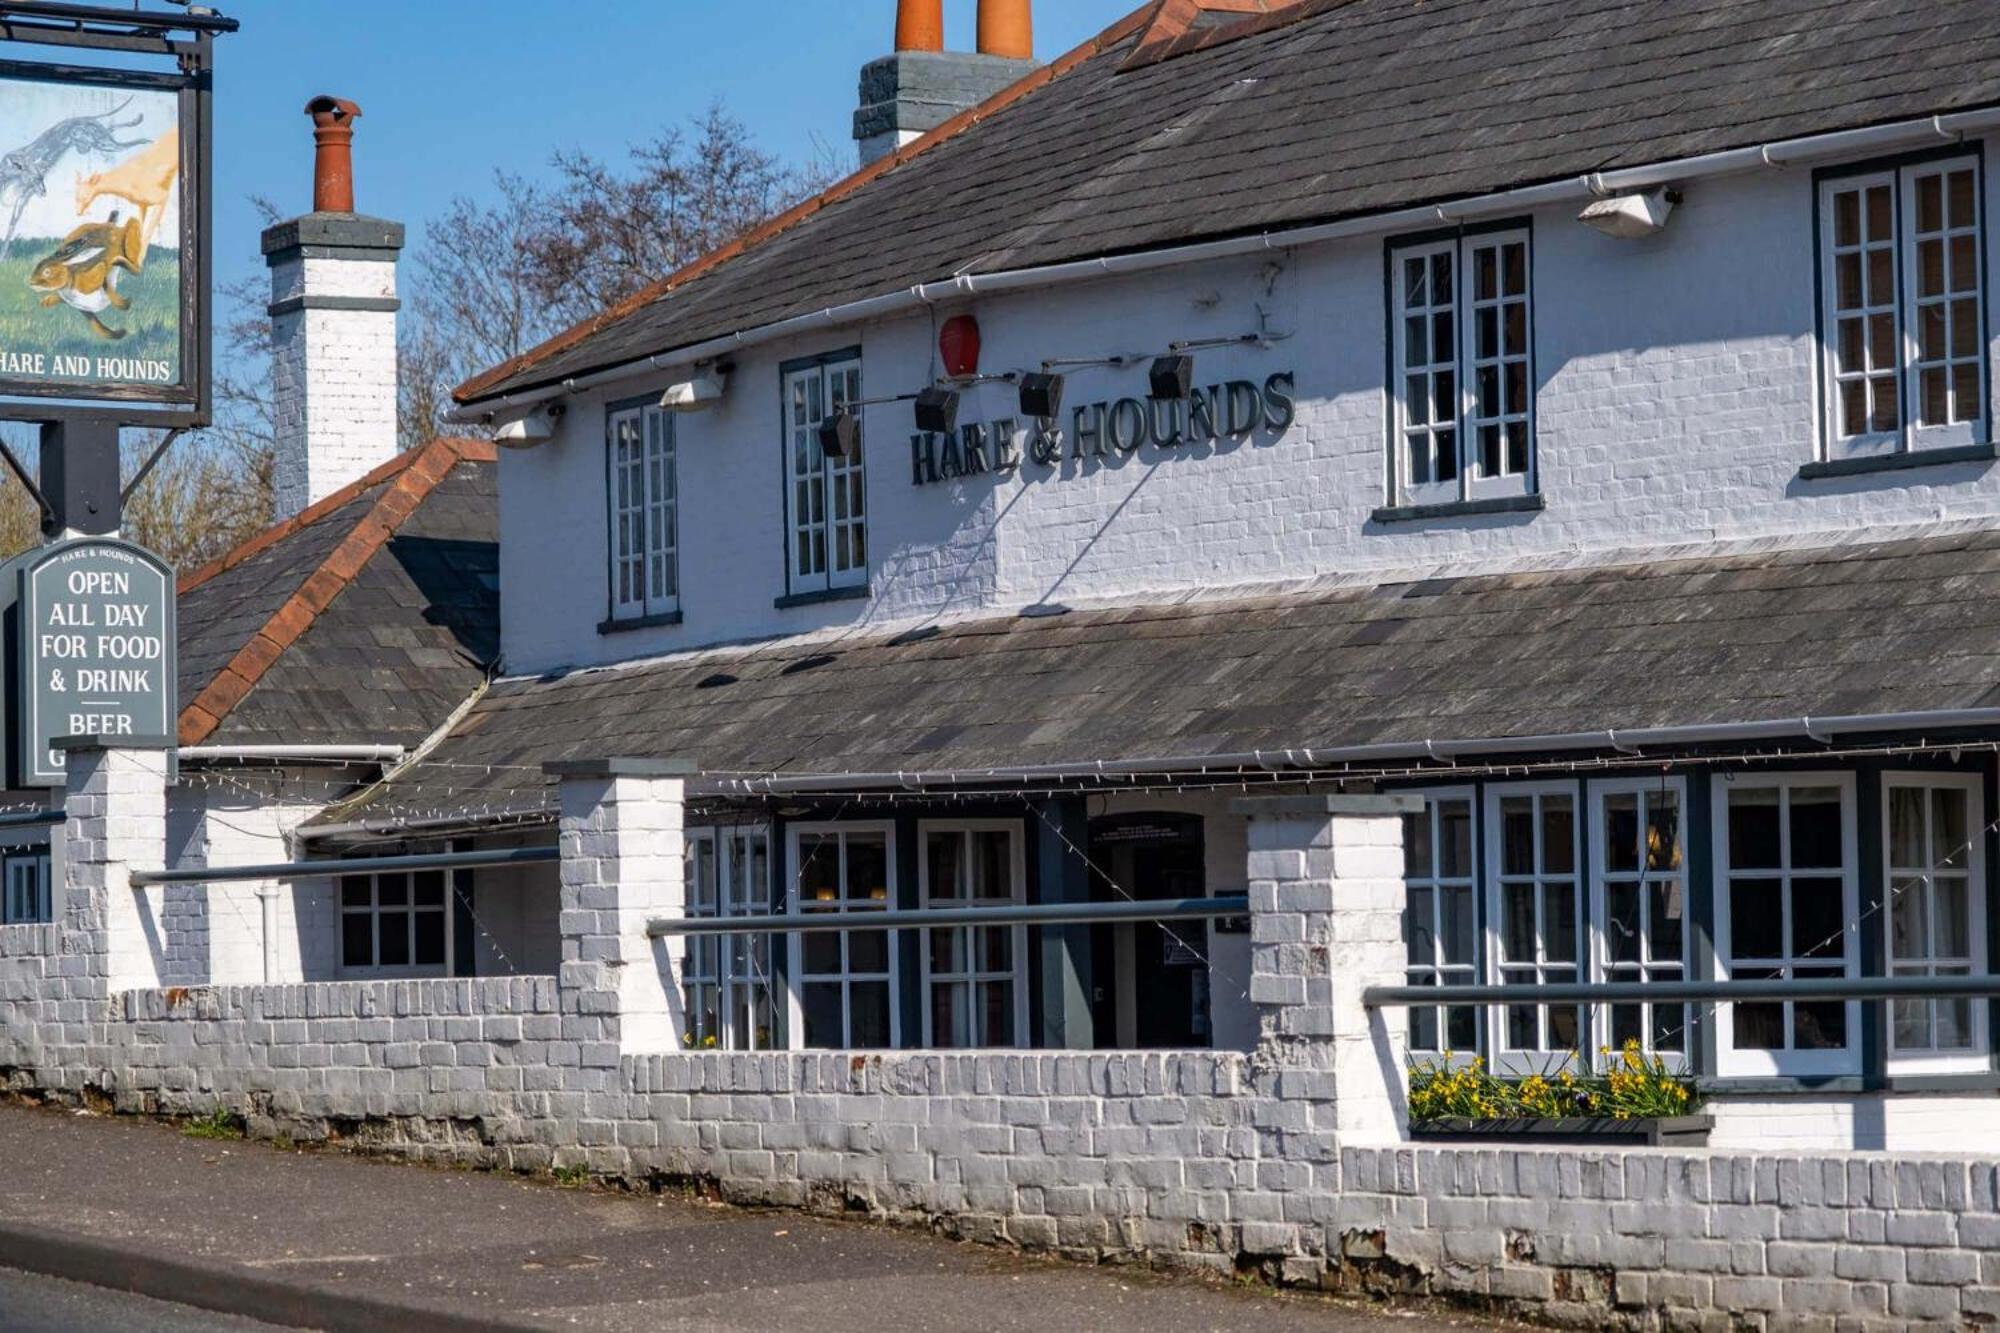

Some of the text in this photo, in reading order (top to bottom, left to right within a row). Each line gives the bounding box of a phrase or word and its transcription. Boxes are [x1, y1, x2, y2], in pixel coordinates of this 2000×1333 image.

[0, 352, 171, 382] HARE AND HOUNDS
[911, 370, 1297, 486] HARE & HOUNDS
[61, 548, 88, 564] HARE
[99, 548, 135, 565] HOUNDS
[68, 570, 129, 595] OPEN
[49, 603, 149, 627] ALL DAY
[41, 634, 160, 660] FOR FOOD
[50, 668, 151, 693] & DRINK
[69, 713, 133, 736] BEER
